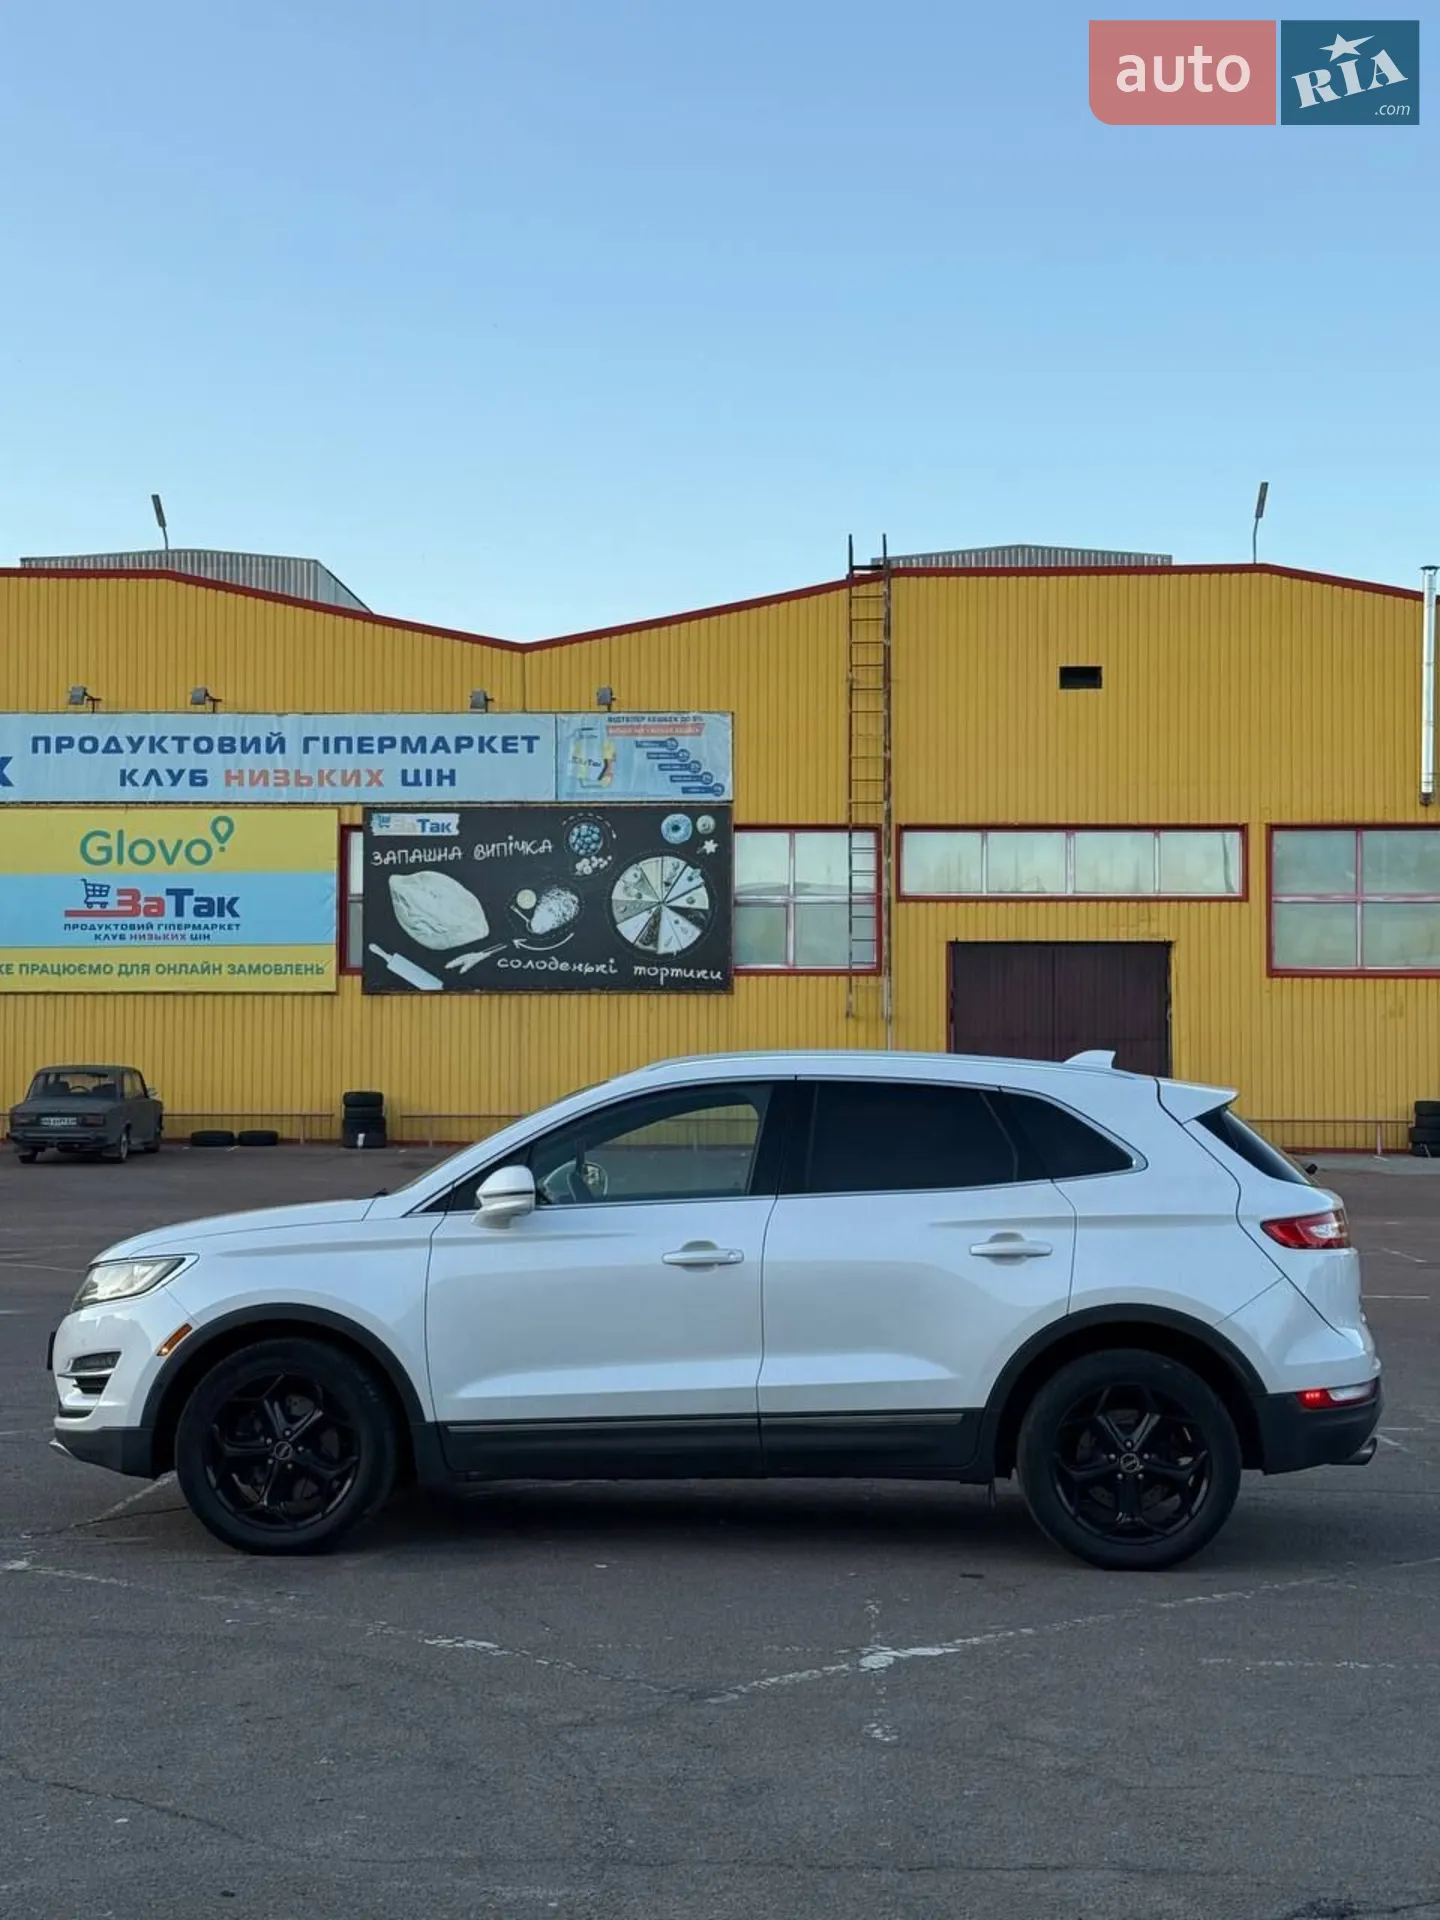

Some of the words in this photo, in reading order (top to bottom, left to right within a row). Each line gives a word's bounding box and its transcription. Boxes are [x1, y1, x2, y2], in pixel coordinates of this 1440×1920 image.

[31, 732, 287, 755] ПРОДУКТОВИЙ
[303, 735, 541, 755] ГІПЕРМАРКЕТ
[119, 768, 209, 788] КЛУБ
[225, 768, 385, 788] НИЗЬКИХ
[401, 768, 457, 789] ЦІН
[79, 828, 214, 867] Glovo
[371, 846, 463, 866] ЗАПАШНА
[473, 835, 553, 860] ВИПІЧКА
[116, 888, 241, 919] ЗаТак
[64, 922, 153, 932] ПРОДУКТОВИЙ
[157, 922, 241, 932] ГІПЕРМАРКЕТ
[94, 933, 127, 942] КЛУБ
[129, 933, 187, 942] НИЗЬКИХ
[189, 933, 211, 942] ЦІН
[19, 963, 114, 978] ПРАЦЮЄМО
[118, 963, 151, 978] ДЛЯ
[155, 960, 222, 976] ОНЛАЙН
[227, 963, 325, 976] ЗАМОВЛЕНЬ
[497, 956, 619, 975] солоденькі
[633, 964, 724, 985] тортики
